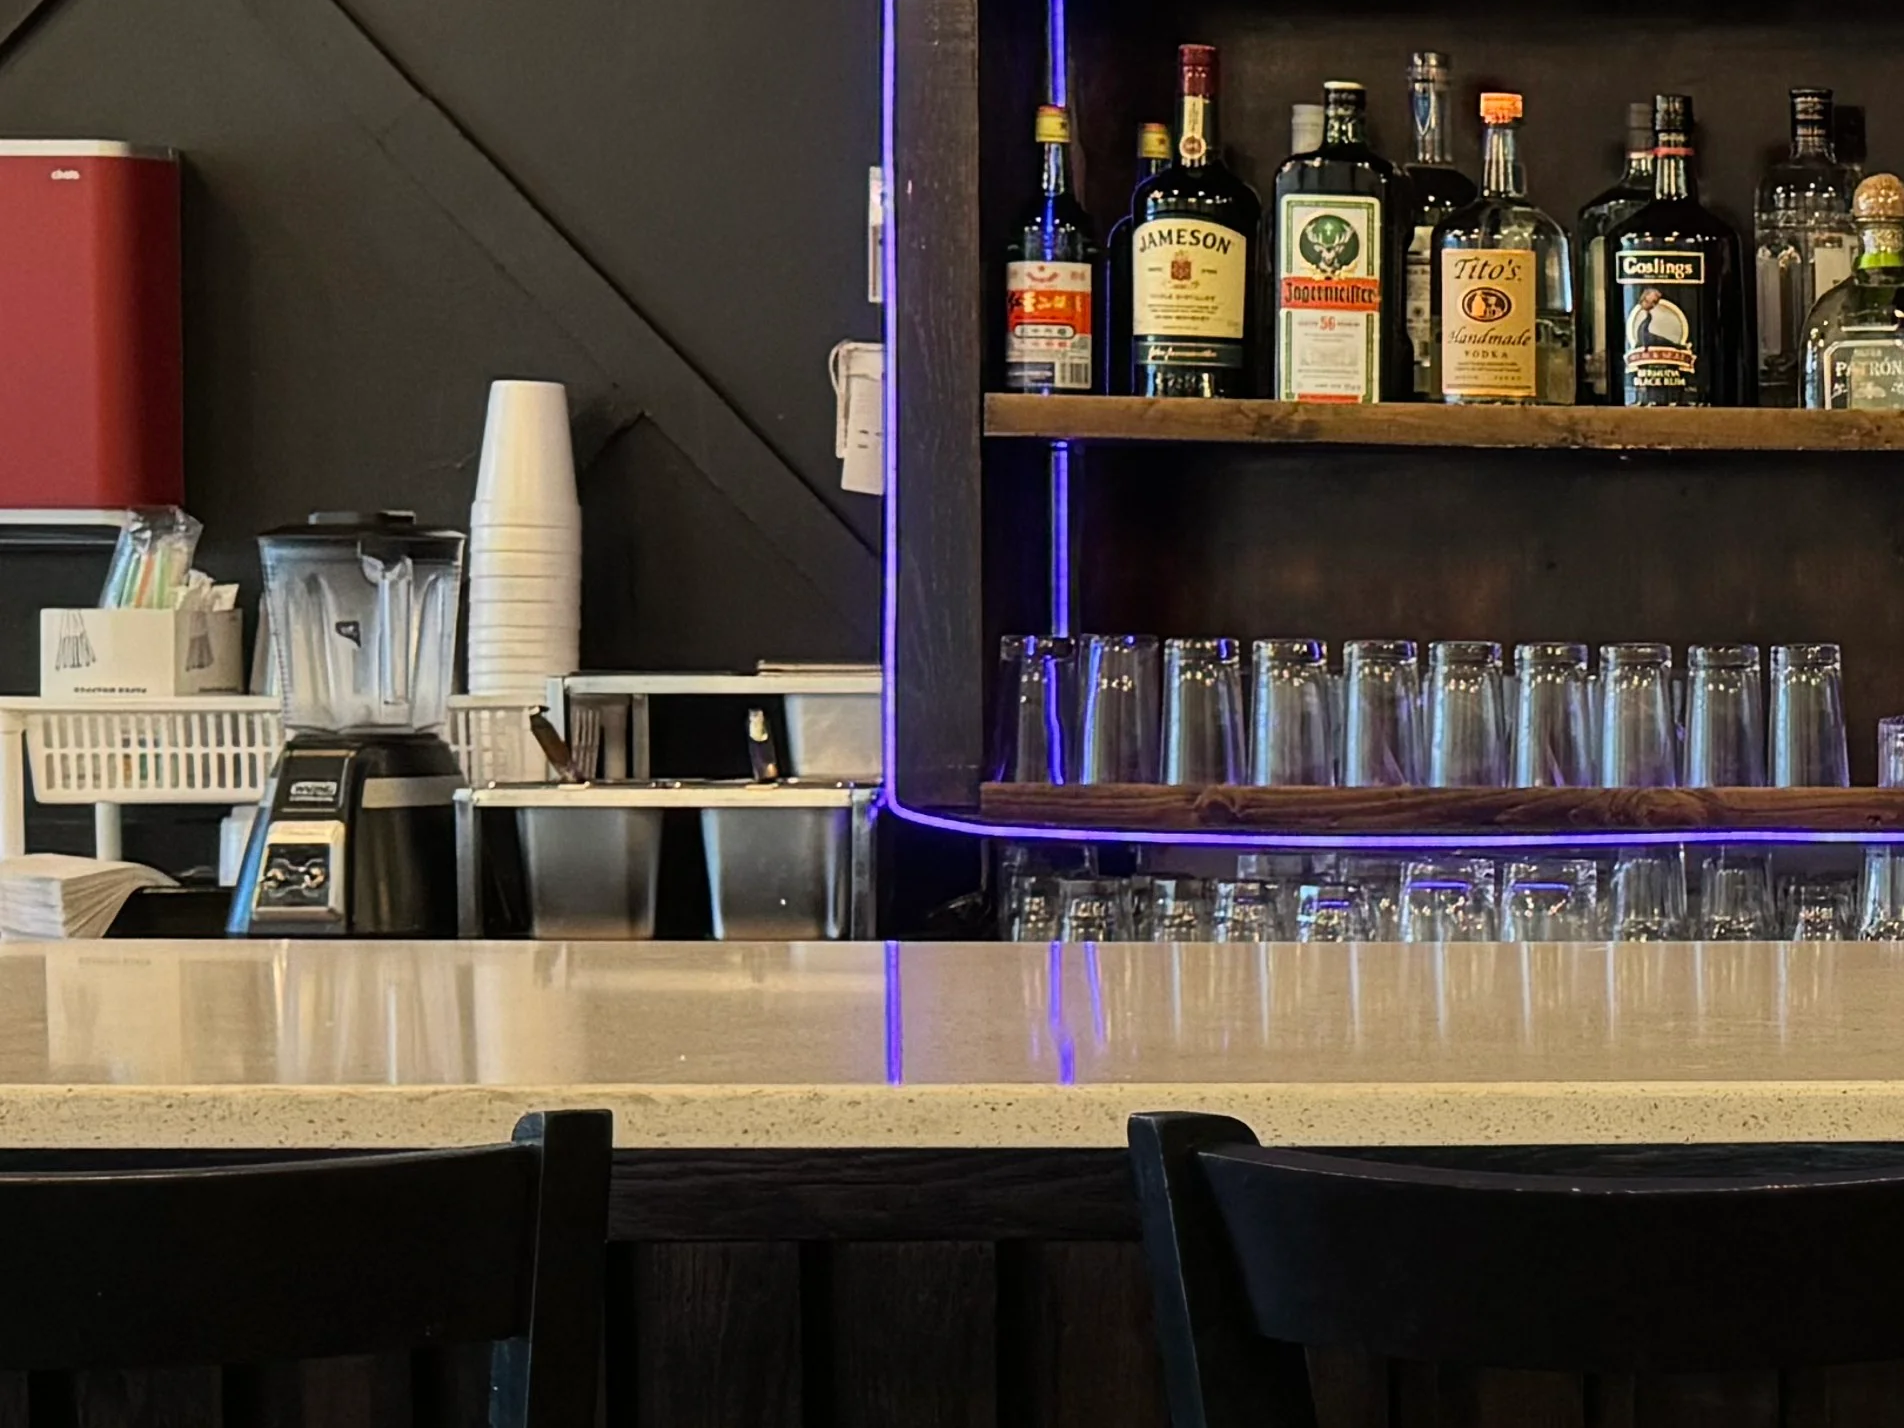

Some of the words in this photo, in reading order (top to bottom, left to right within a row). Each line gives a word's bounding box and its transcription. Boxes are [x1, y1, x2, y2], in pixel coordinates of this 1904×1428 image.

[1139, 227, 1232, 255] JAMESON
[1622, 256, 1694, 280] Goslings
[1447, 326, 1532, 348] Handmade
[1464, 349, 1509, 359] VODKA
